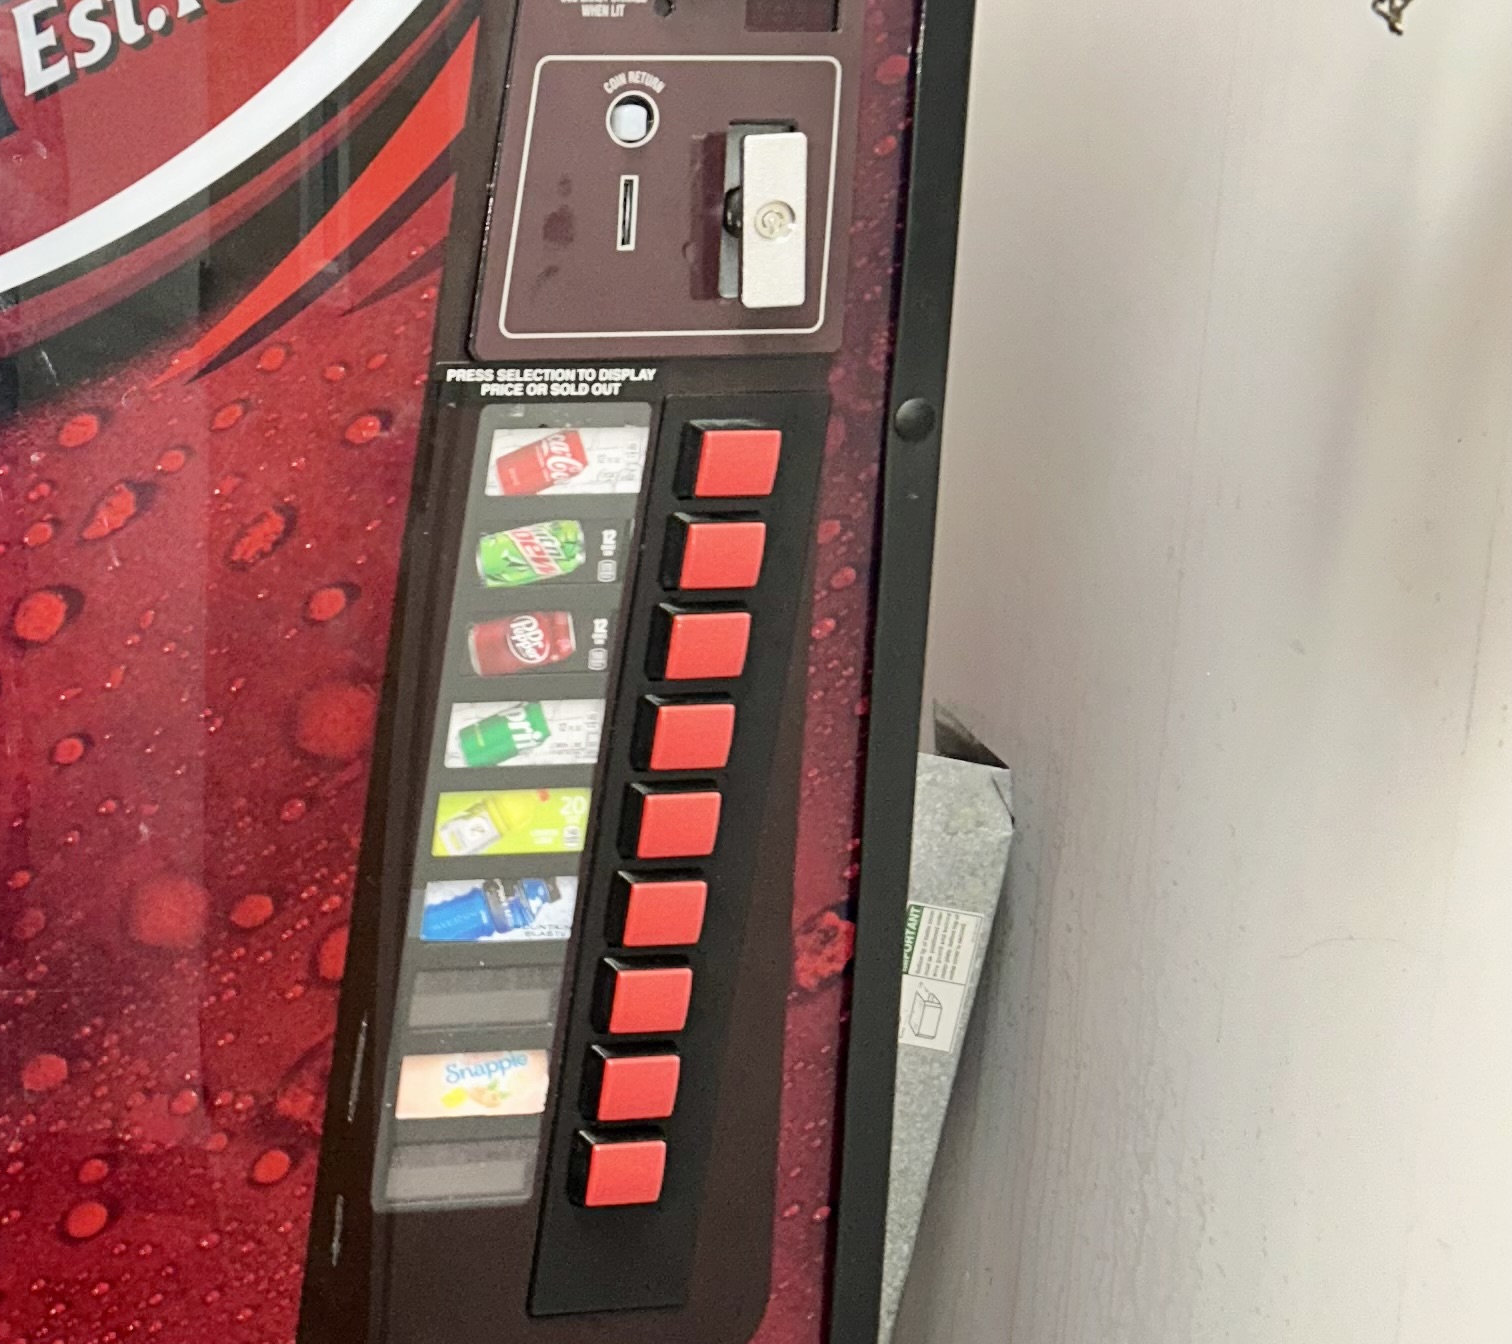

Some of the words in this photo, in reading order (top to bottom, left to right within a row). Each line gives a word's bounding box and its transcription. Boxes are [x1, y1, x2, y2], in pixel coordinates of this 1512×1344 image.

[581, 3, 609, 17] WHEN
[610, 4, 626, 17] LIT
[603, 72, 627, 94] COIN
[628, 70, 666, 94] RETURN
[446, 368, 494, 382] PRESS
[496, 368, 576, 382] SELECTION
[576, 369, 597, 382] TO
[598, 368, 657, 382] DISPLAY
[480, 383, 524, 396] PRICE
[525, 383, 548, 396] OR
[549, 383, 589, 396] SOLD
[590, 382, 622, 396] OUT
[560, 795, 587, 816] 20
[445, 1052, 528, 1084] Snapple
